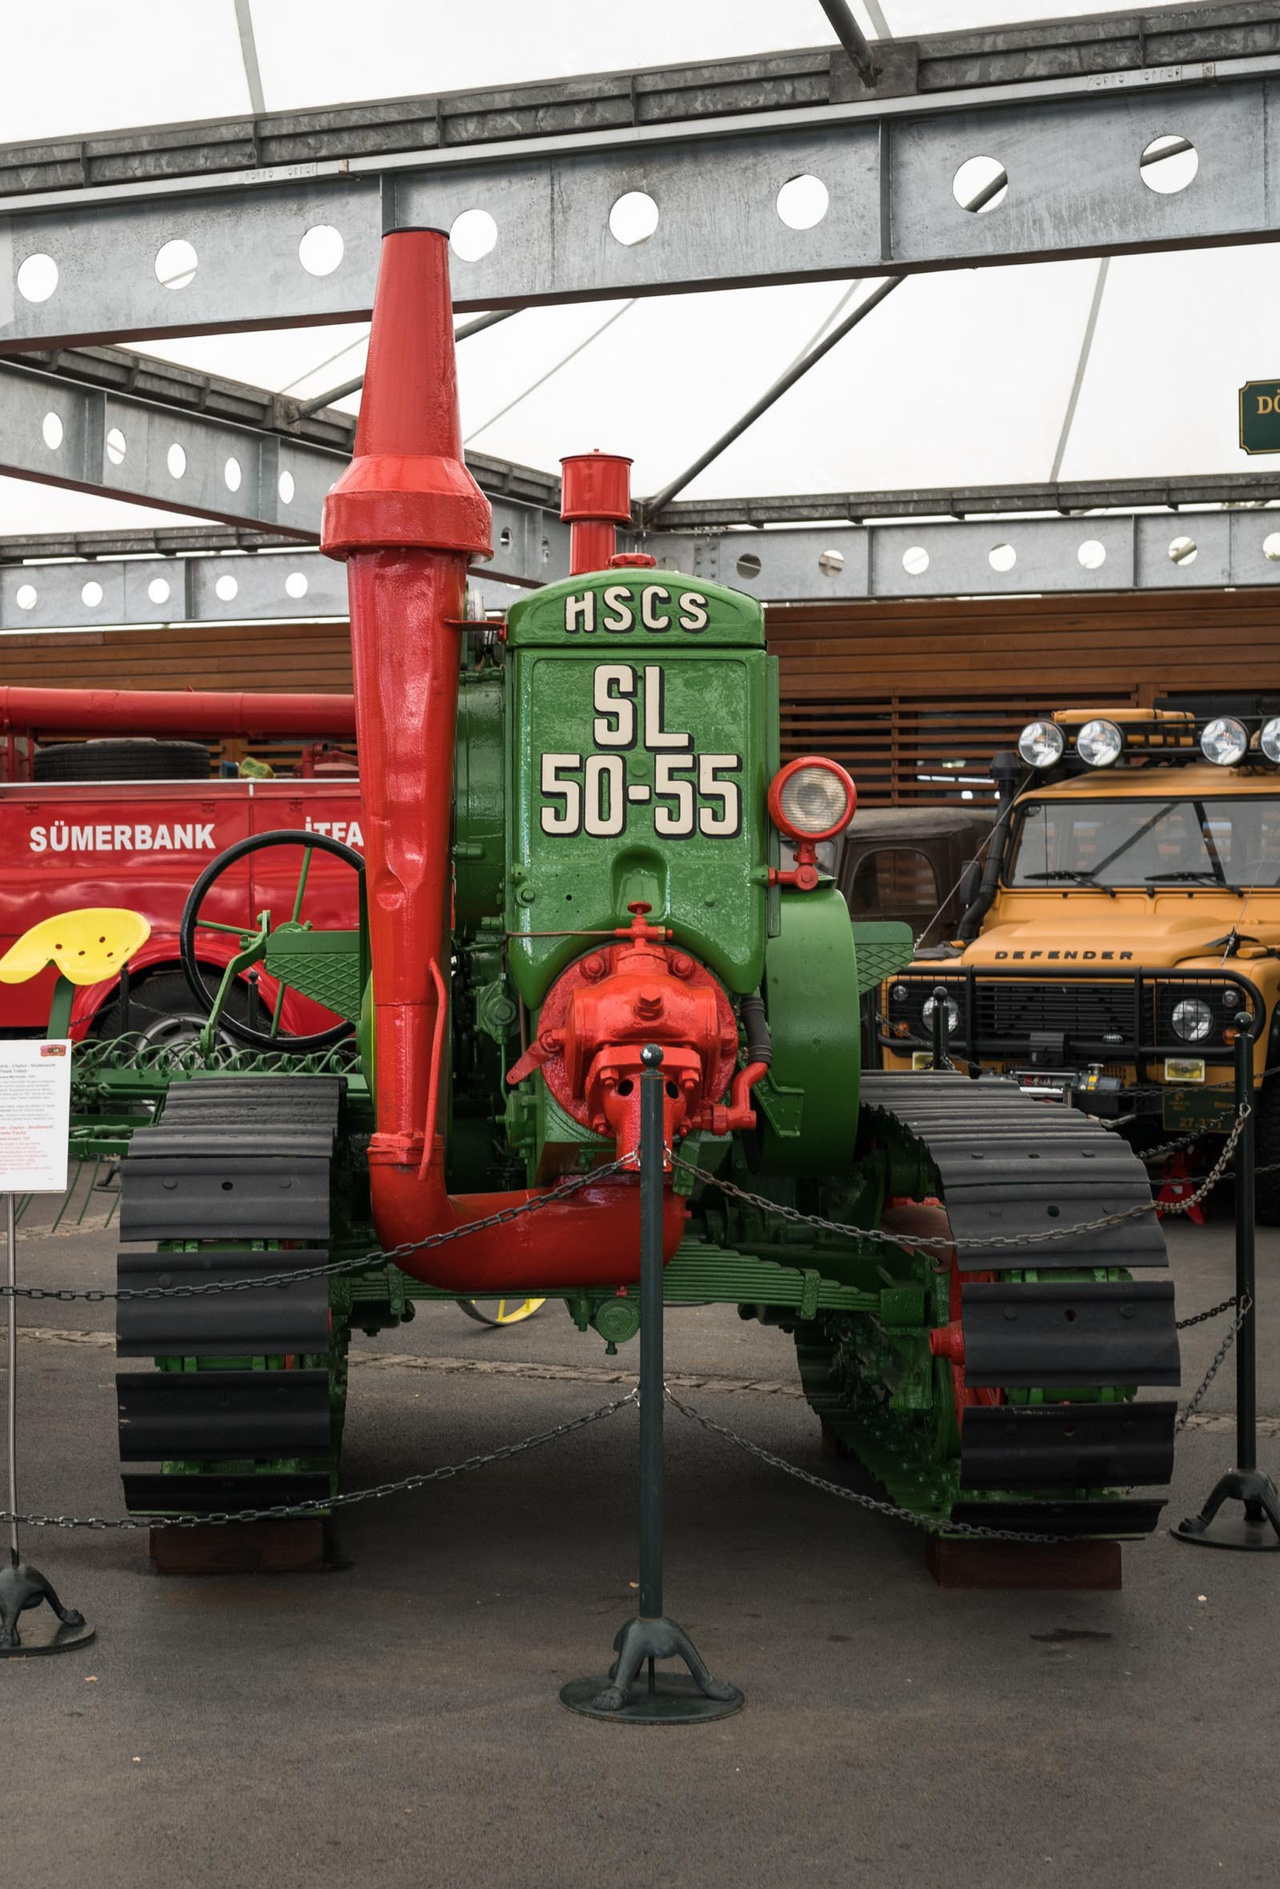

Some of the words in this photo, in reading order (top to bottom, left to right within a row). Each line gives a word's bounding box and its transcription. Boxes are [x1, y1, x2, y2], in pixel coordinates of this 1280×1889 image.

[565, 585, 710, 633] HSCS
[593, 664, 694, 750] SL
[540, 753, 742, 838] 50-55
[29, 820, 216, 852] SÜMERBANK
[994, 950, 1134, 961] DEFENDER
